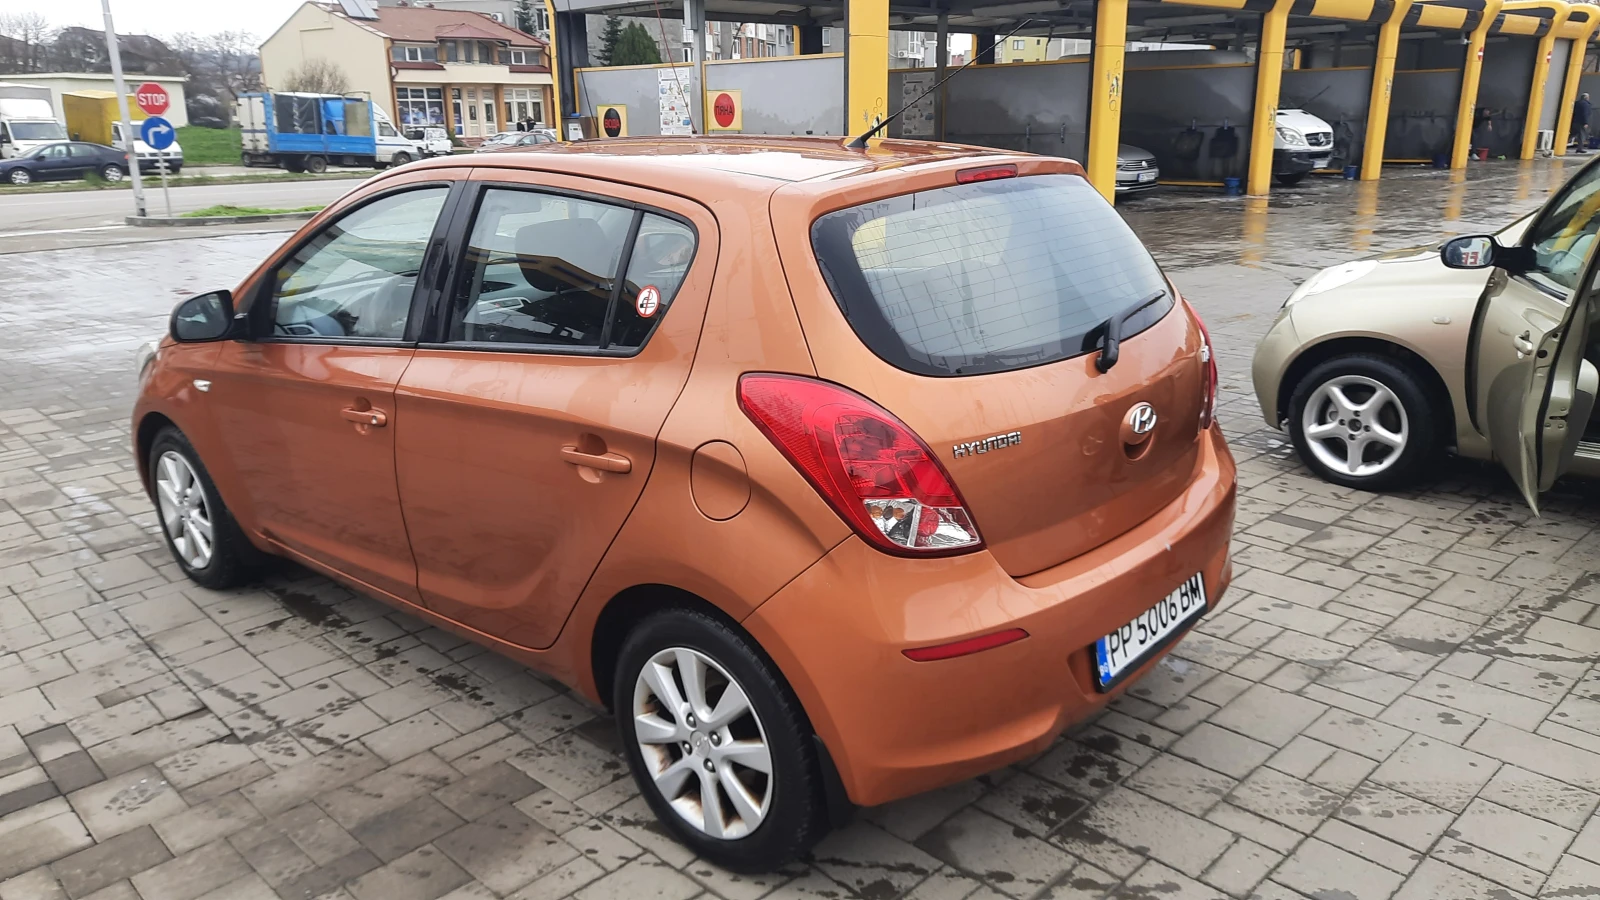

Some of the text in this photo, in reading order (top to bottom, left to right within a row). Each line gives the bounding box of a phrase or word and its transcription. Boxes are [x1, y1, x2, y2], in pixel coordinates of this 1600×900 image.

[138, 93, 166, 106] STOP
[715, 105, 733, 116] ПЯНА
[604, 118, 620, 129] ВОДА
[953, 431, 1022, 459] HYUNDAI
[1109, 575, 1202, 667] PP 5006 BM
